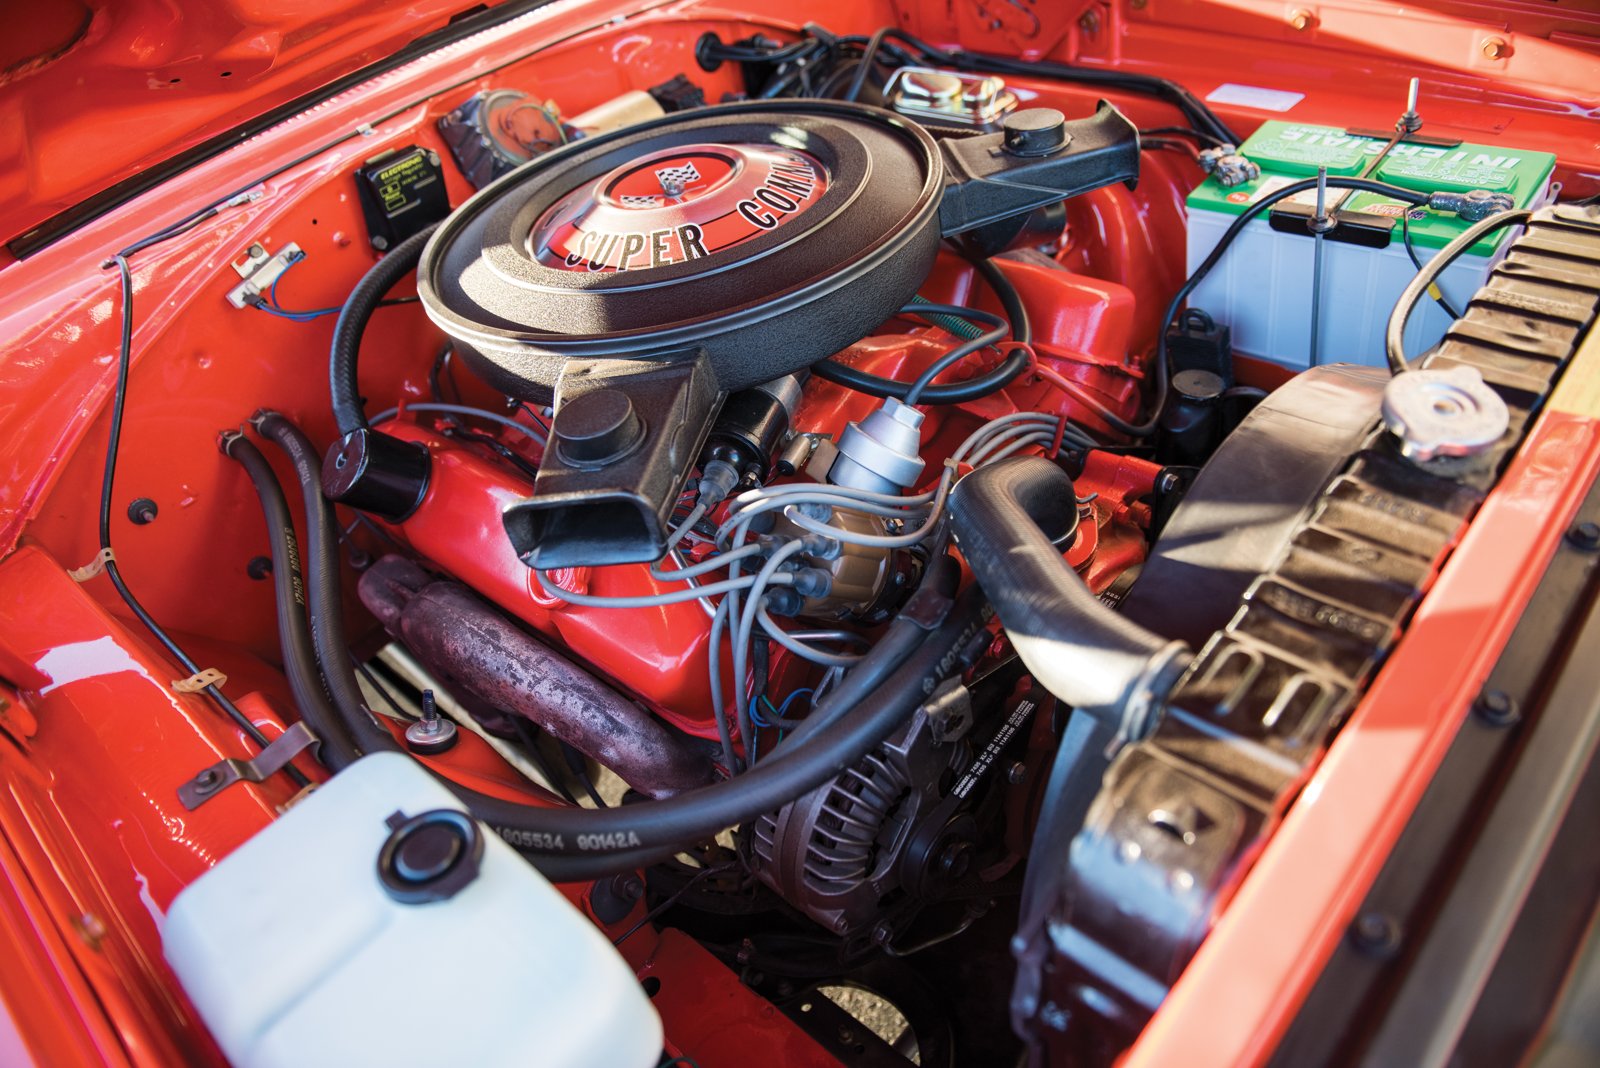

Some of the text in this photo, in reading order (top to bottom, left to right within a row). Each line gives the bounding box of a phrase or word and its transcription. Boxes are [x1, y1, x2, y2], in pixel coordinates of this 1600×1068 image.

[380, 155, 422, 180] ELECTRONIC
[736, 157, 817, 231] COMM
[564, 222, 711, 273] SUPER
